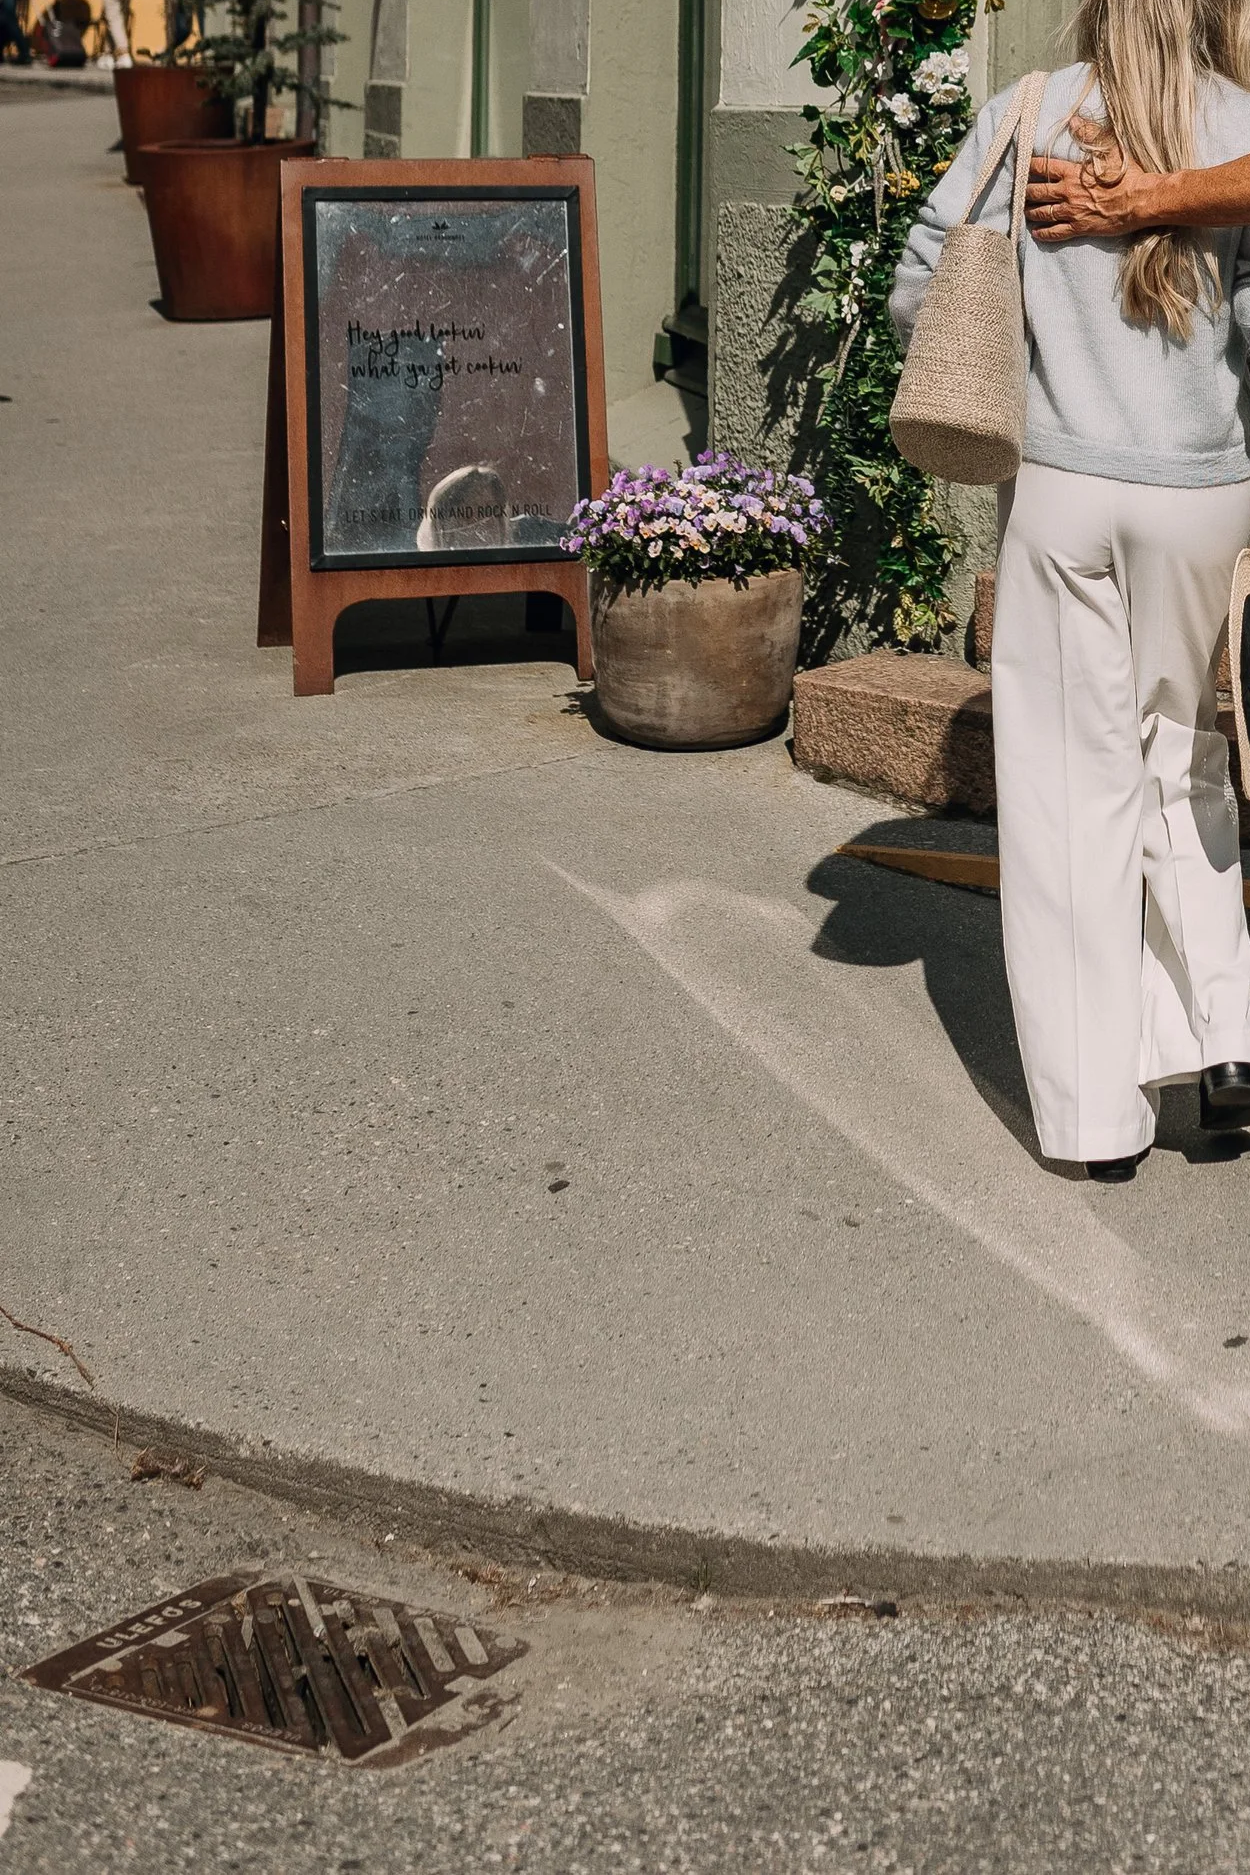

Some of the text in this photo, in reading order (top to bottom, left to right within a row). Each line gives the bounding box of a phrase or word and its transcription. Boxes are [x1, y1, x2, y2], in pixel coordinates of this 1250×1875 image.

[347, 320, 383, 354] Hey
[384, 319, 426, 357] good
[351, 345, 400, 380] what
[429, 355, 461, 391] got
[408, 506, 445, 522] DRINK
[448, 505, 474, 520] AND
[478, 504, 508, 519] ROCK
[524, 503, 553, 518] ROLL
